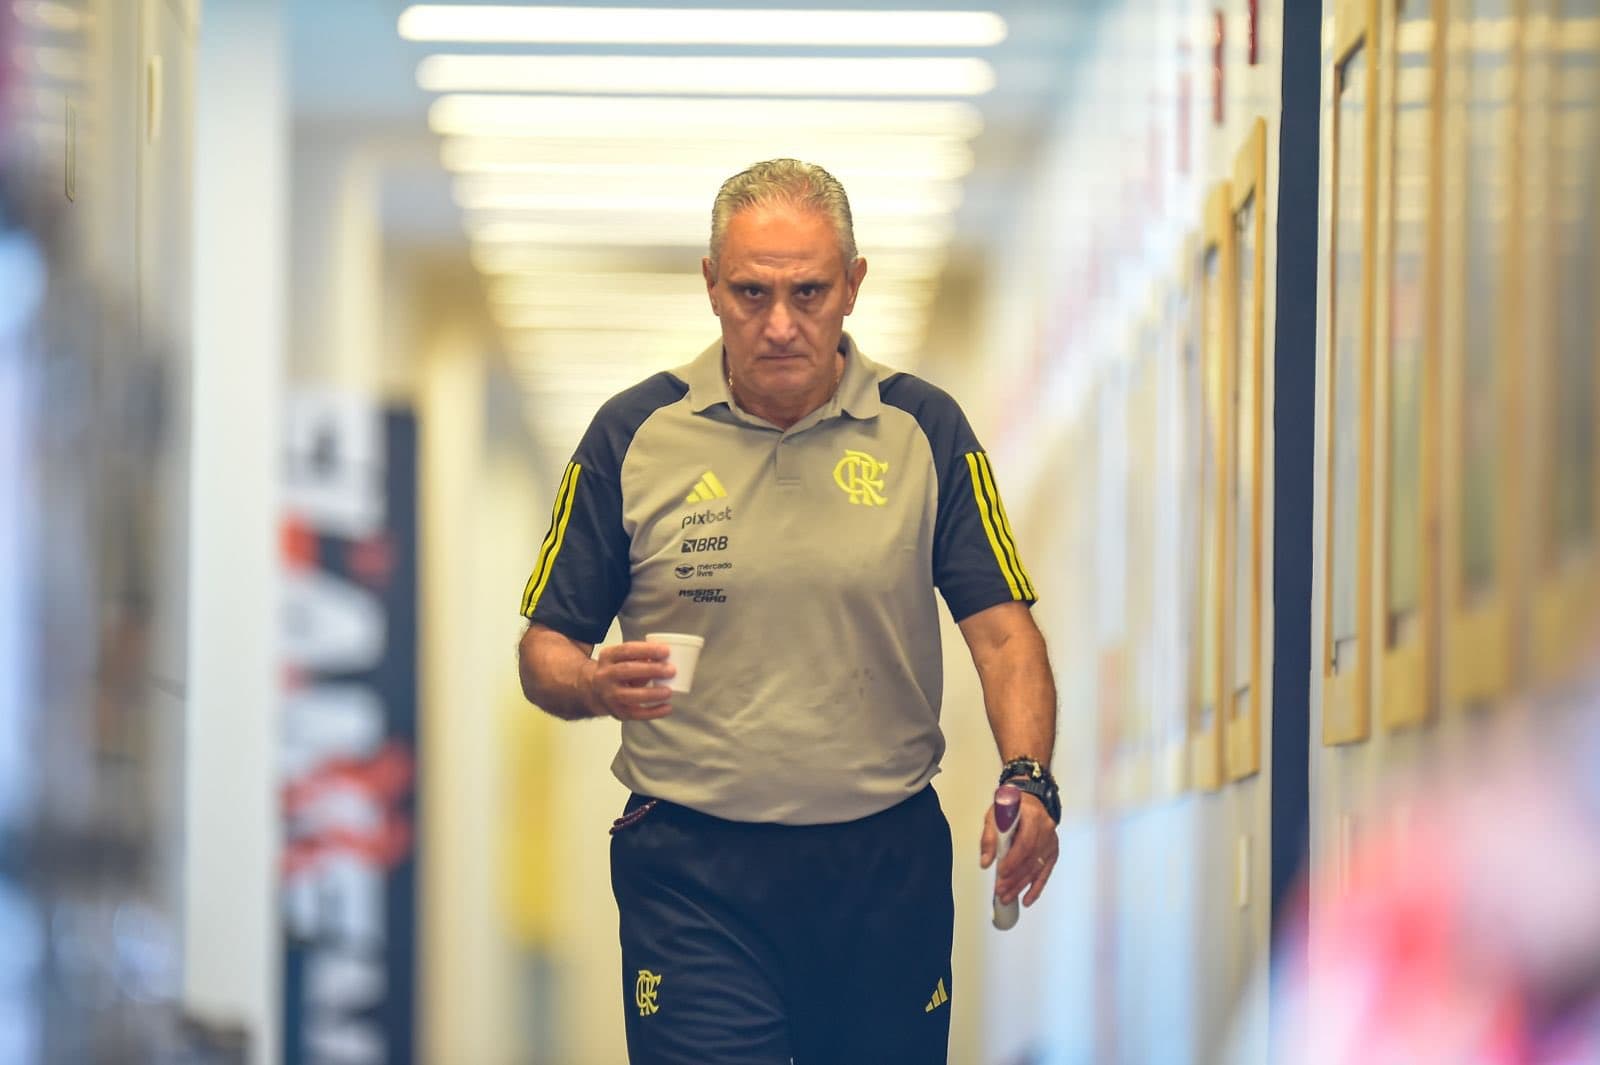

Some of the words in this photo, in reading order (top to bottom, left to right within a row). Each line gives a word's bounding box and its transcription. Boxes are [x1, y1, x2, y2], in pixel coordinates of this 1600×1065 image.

[696, 536, 728, 552] BRB
[697, 562, 732, 570] mercado
[679, 588, 723, 597] ASSIST
